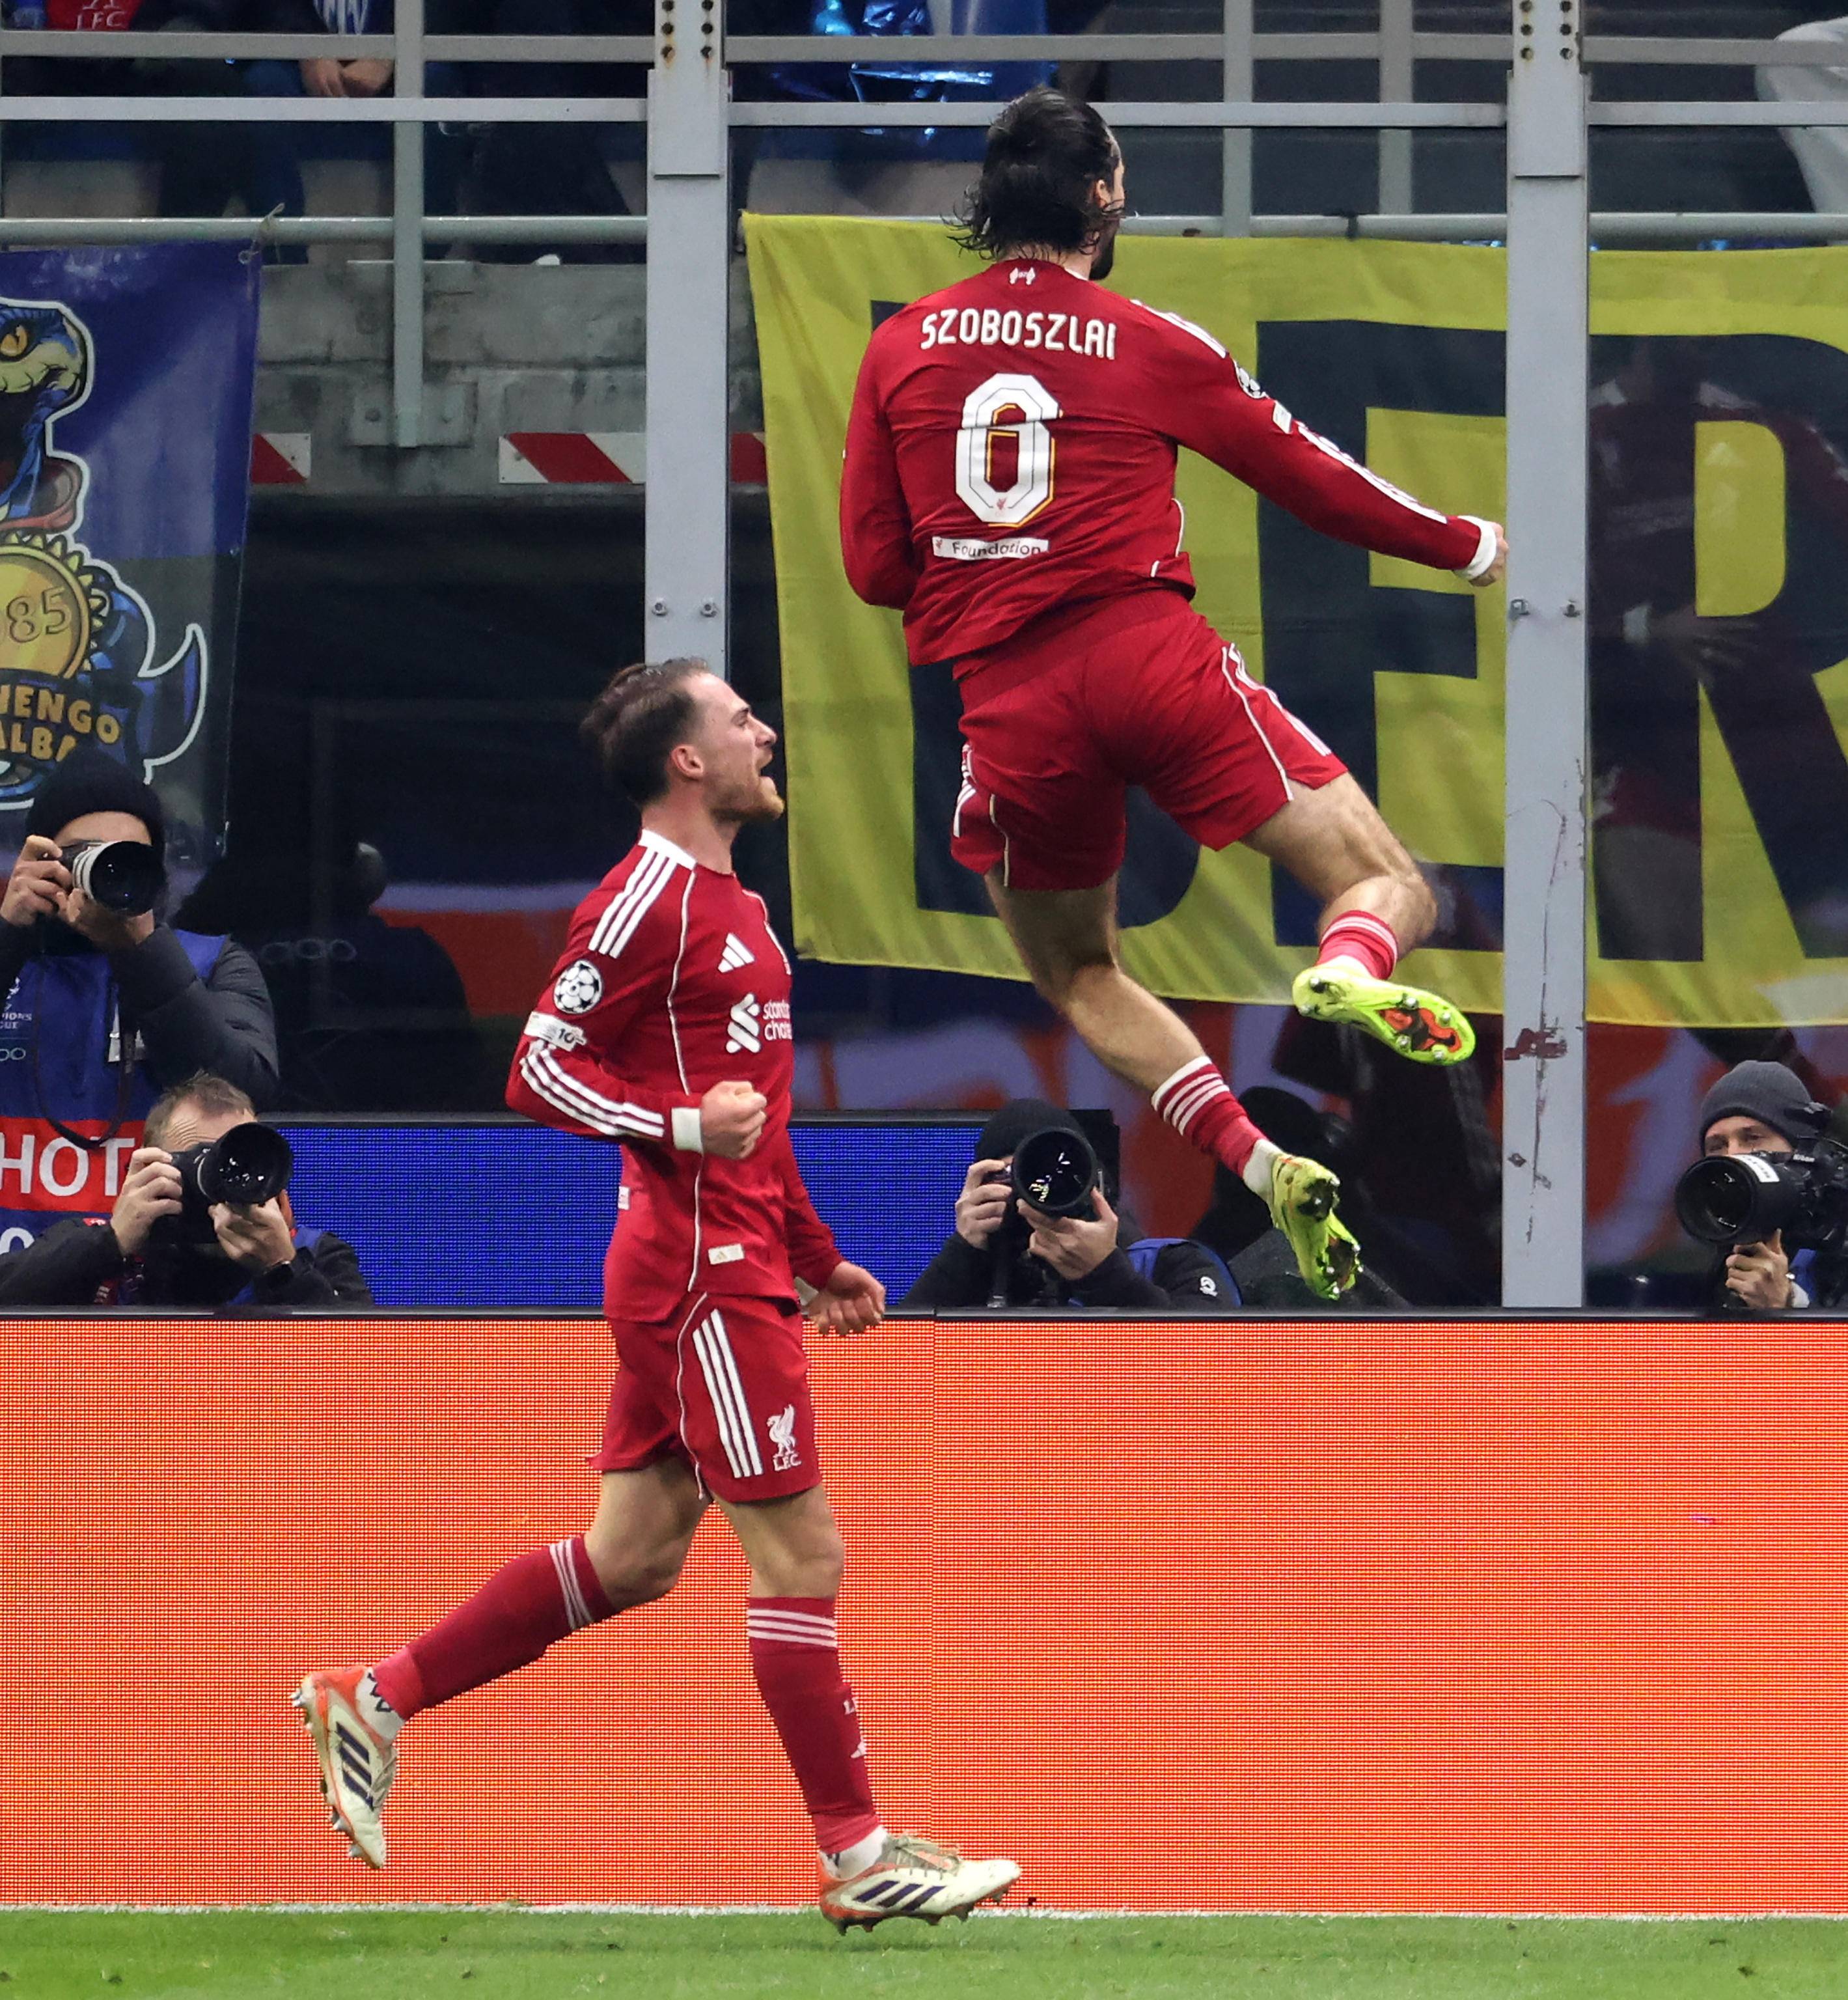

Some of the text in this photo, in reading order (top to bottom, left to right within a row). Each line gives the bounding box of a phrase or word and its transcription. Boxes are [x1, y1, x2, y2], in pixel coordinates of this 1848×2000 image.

[920, 308, 1118, 360] SZOBOSZLAI
[952, 540, 1041, 557] Foundation
[0, 585, 72, 645] 85
[2, 1012, 33, 1021] IONS
